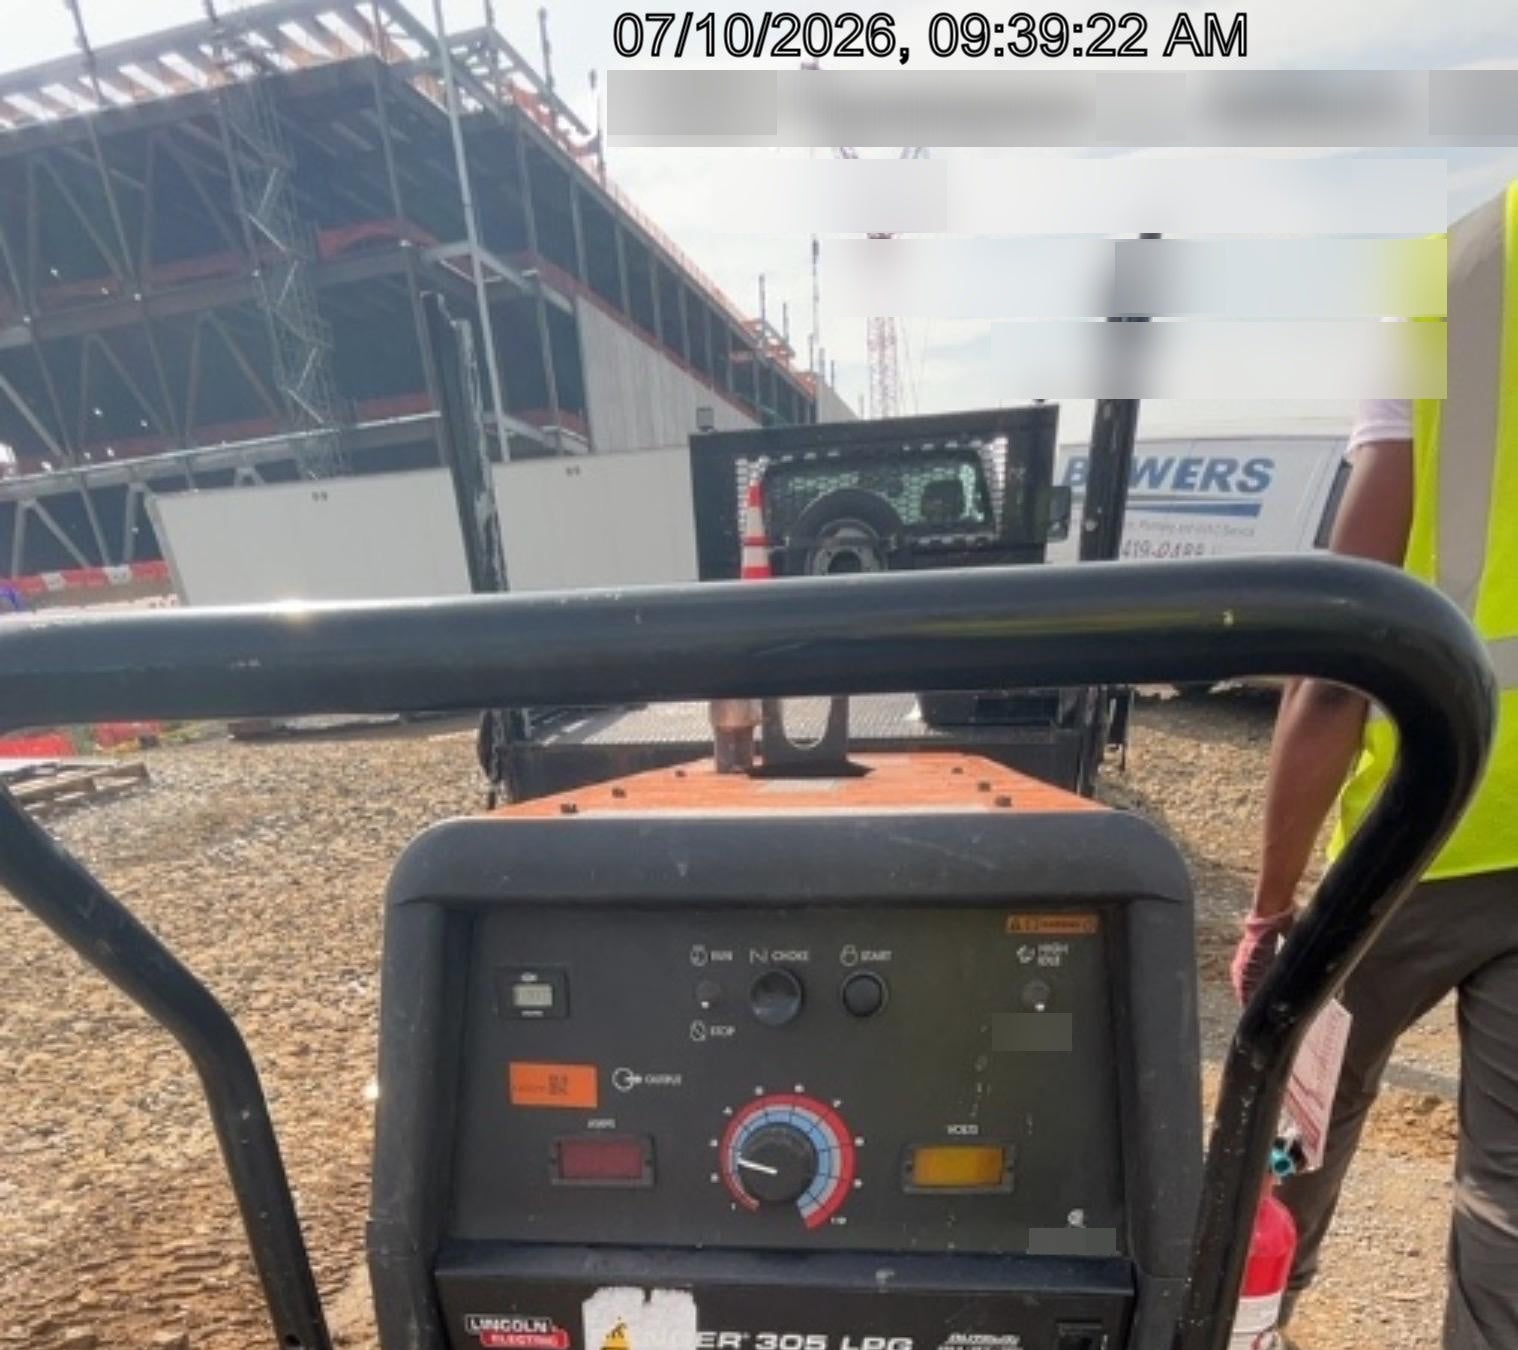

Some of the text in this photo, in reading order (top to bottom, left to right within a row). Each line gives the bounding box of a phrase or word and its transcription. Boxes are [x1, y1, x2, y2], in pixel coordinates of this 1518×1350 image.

[1062, 456, 1275, 493] BWERS
[770, 950, 809, 961] CHOKE
[471, 1317, 547, 1334] LINCOLN
